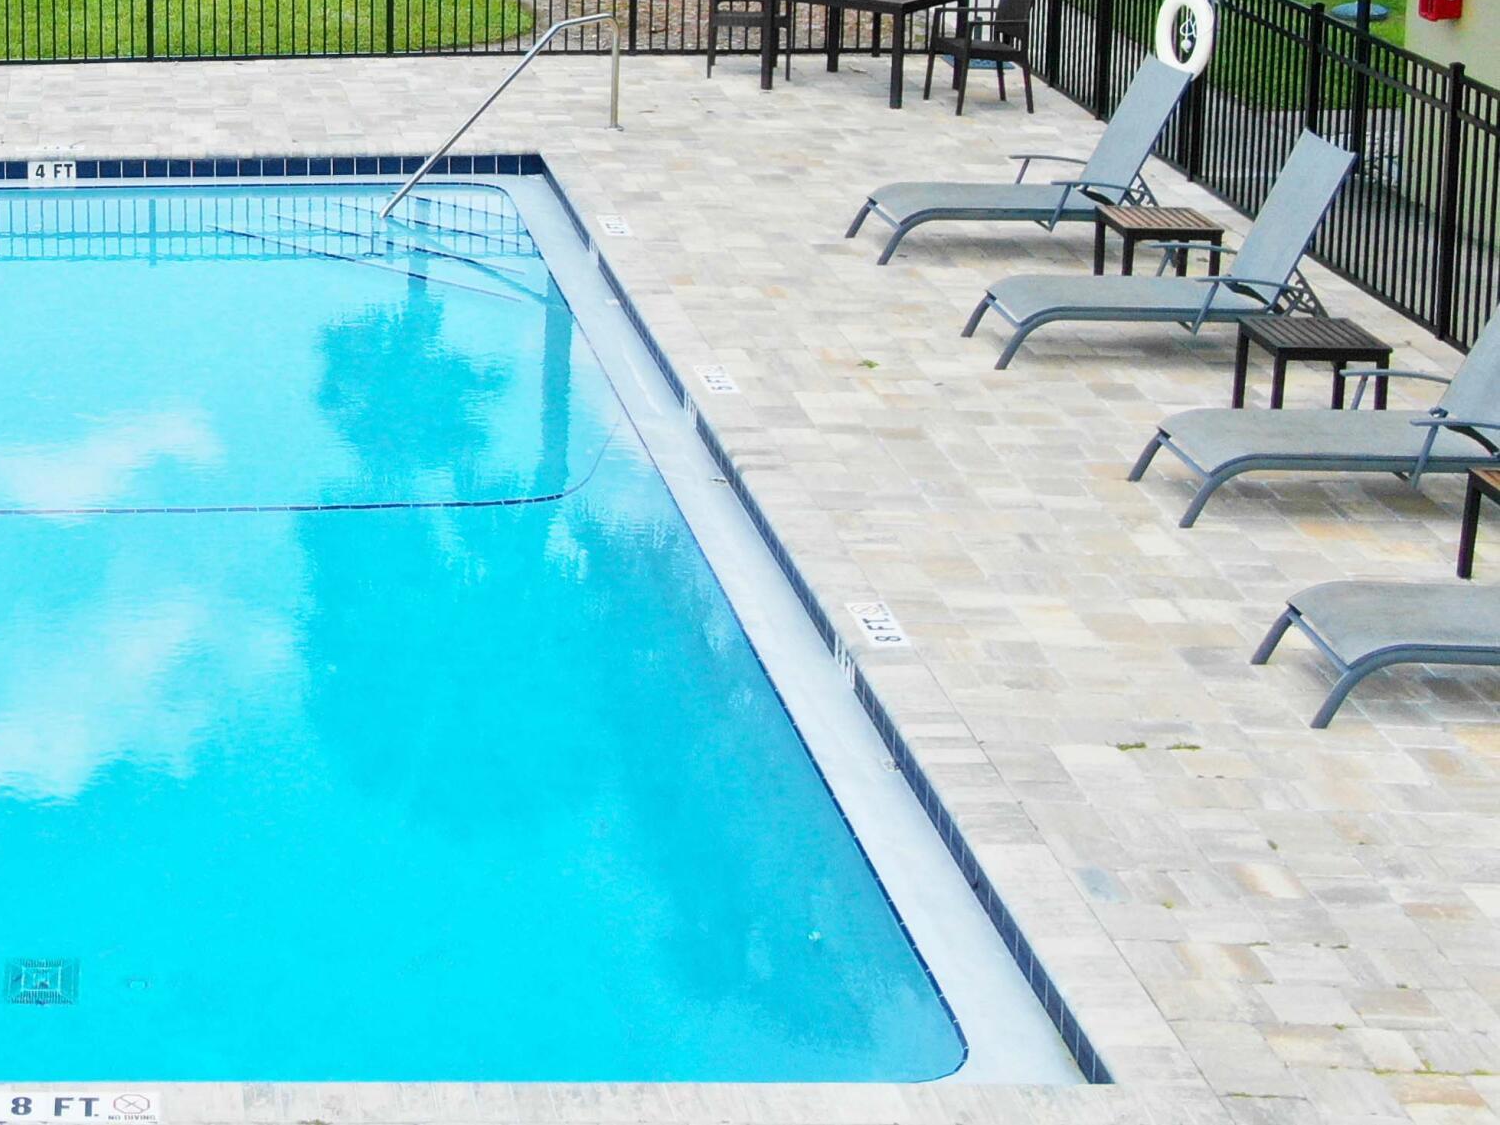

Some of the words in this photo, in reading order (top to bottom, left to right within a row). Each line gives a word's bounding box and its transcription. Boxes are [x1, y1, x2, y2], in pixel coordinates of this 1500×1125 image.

[35, 164, 46, 178] 4
[53, 163, 73, 178] FT
[10, 1096, 33, 1116] 8
